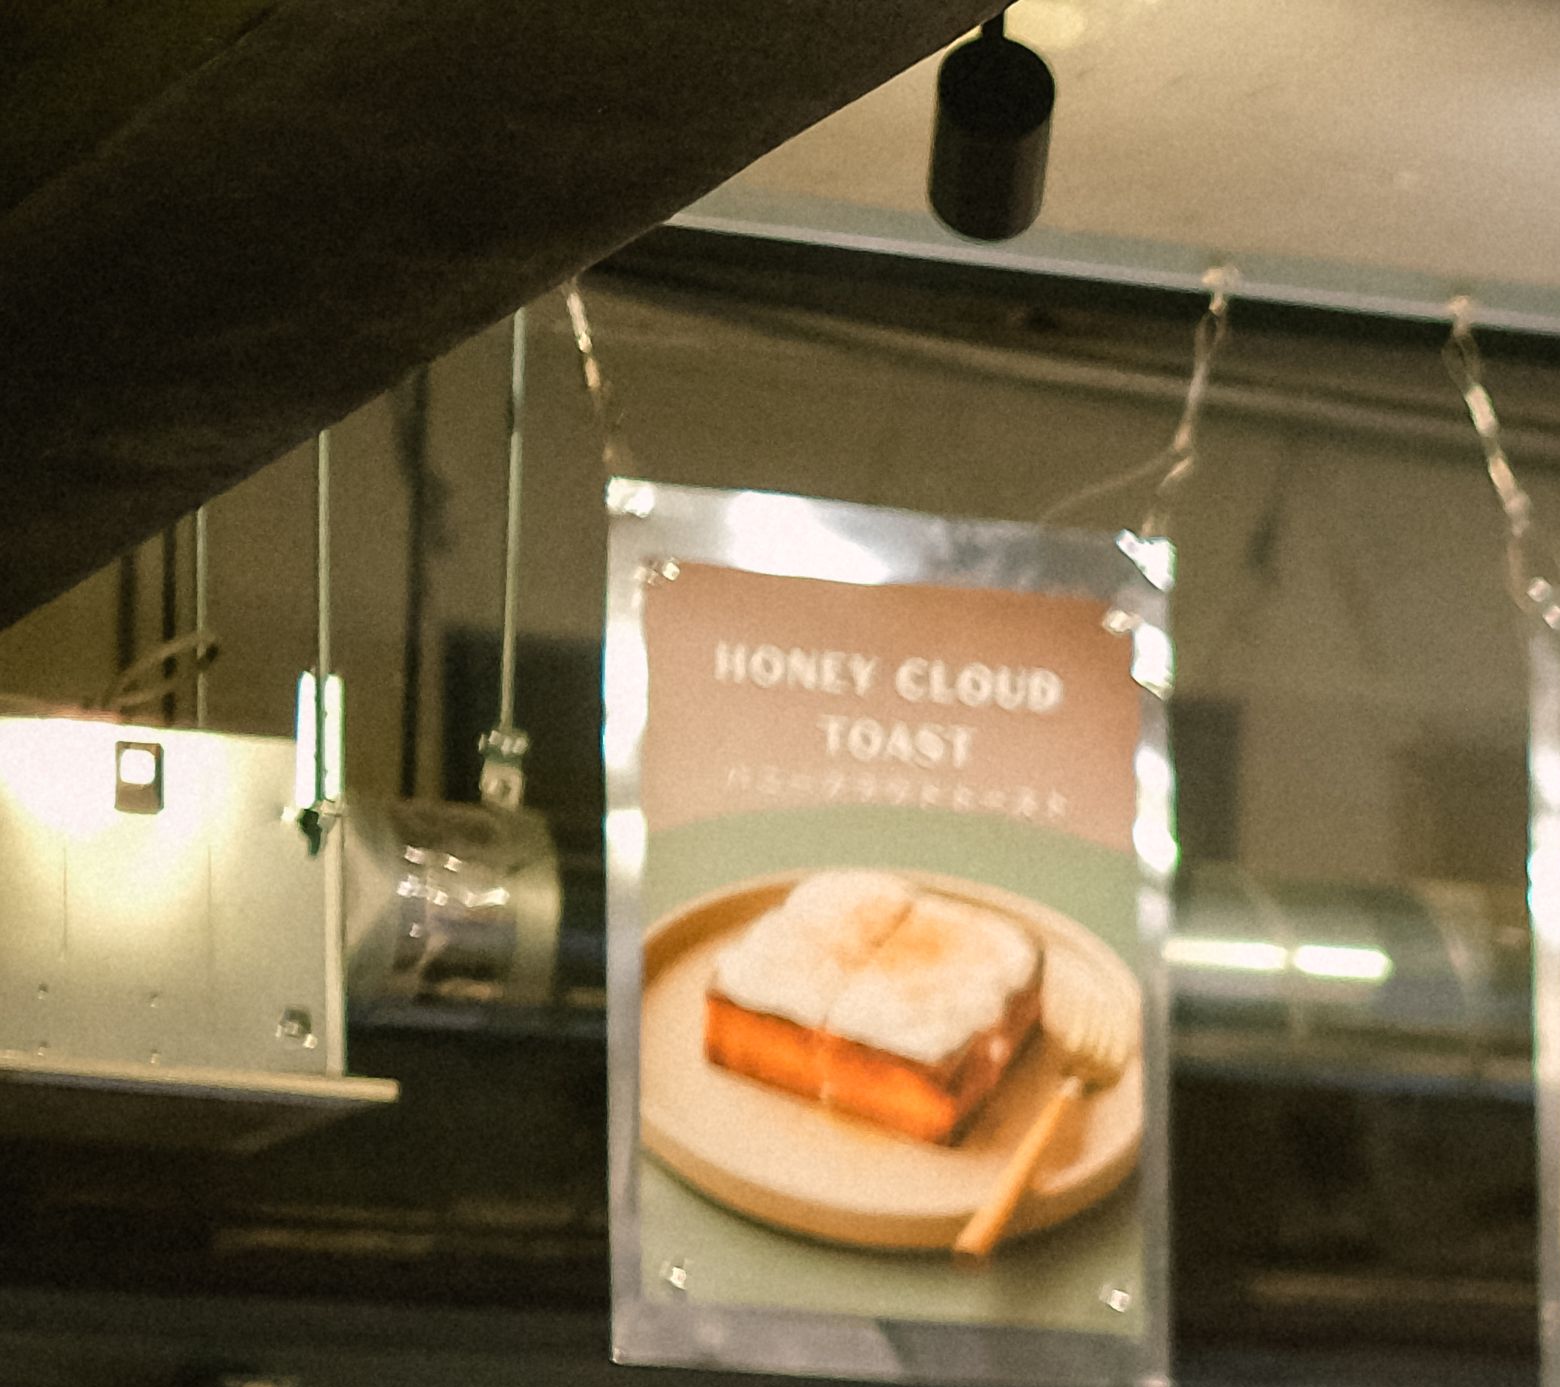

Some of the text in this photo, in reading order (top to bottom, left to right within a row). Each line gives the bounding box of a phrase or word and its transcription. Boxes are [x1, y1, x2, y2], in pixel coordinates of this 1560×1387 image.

[713, 640, 1065, 714] HONEY CLOUD
[817, 712, 976, 769] TOAST
